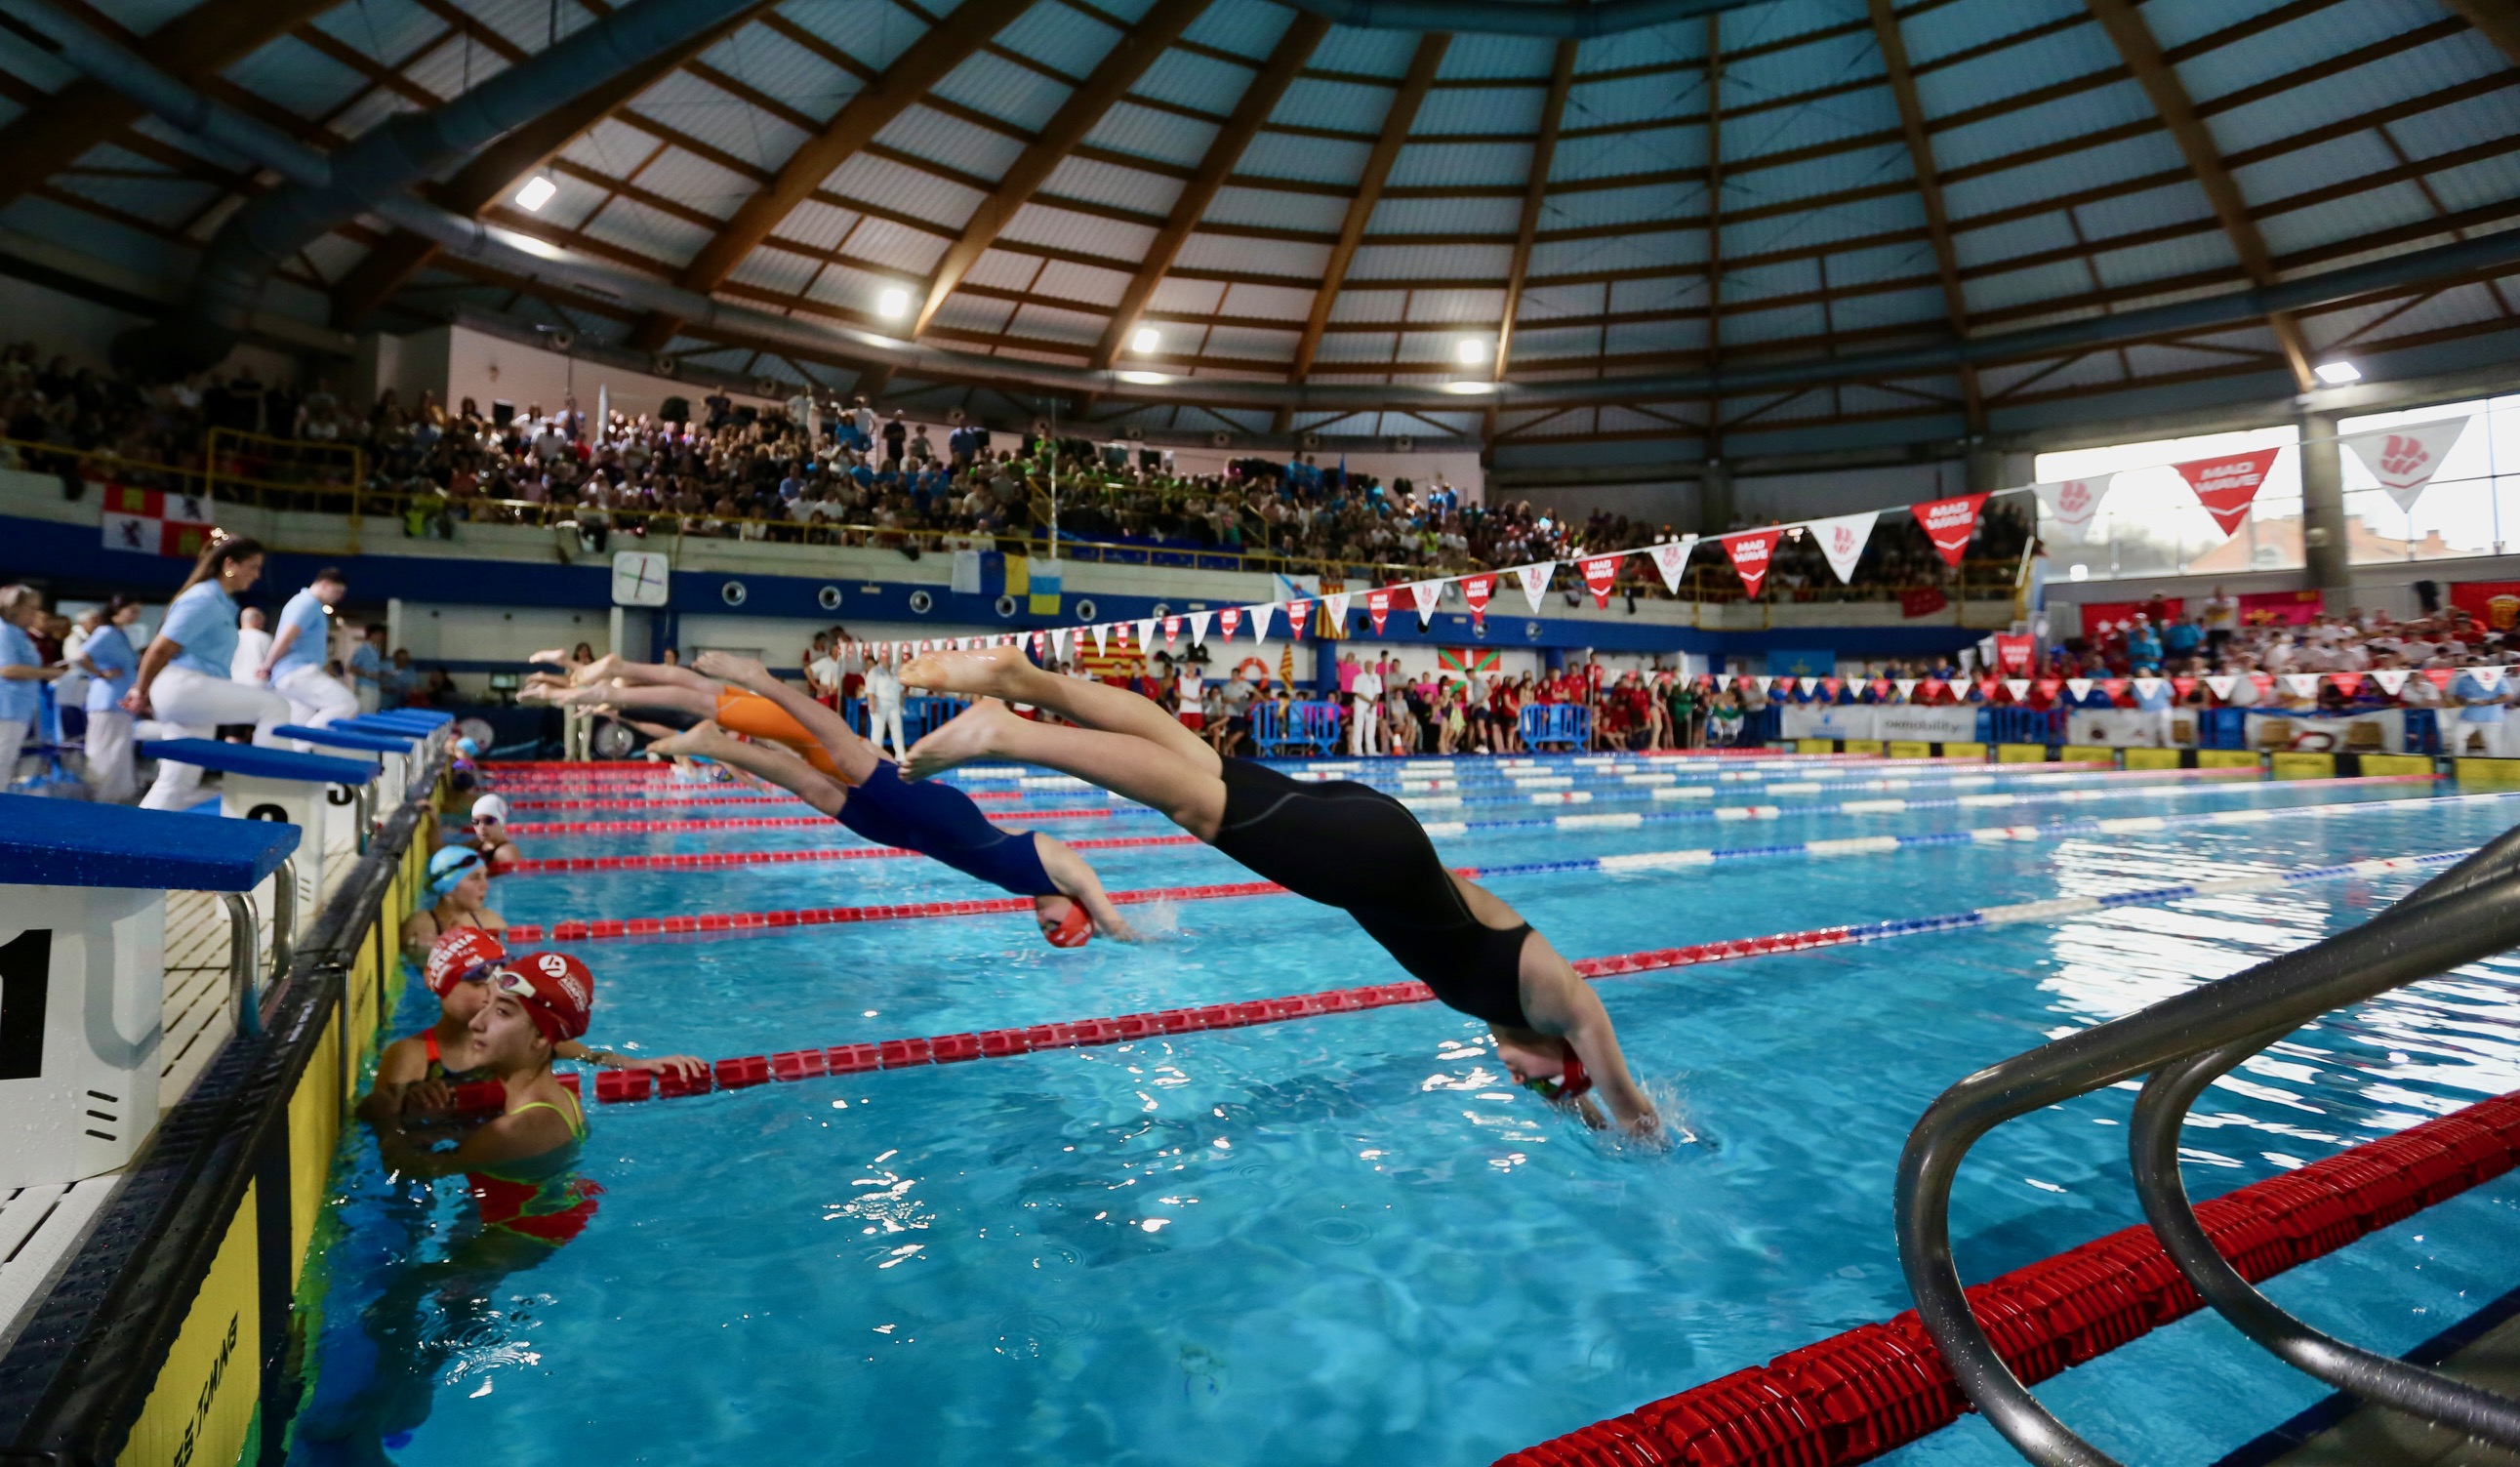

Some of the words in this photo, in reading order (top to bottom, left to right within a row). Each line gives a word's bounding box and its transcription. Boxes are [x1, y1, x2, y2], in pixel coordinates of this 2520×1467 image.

[2201, 461, 2256, 481] MAD
[2194, 473, 2261, 494] WAVE
[1930, 501, 1970, 518] MAD
[1925, 511, 1973, 530] WAVE
[1735, 539, 1766, 552] MAD
[1732, 549, 1768, 563] WAVE
[1586, 567, 1614, 580] WAVE
[1588, 559, 1612, 571] MAD
[0, 928, 53, 1080] 1
